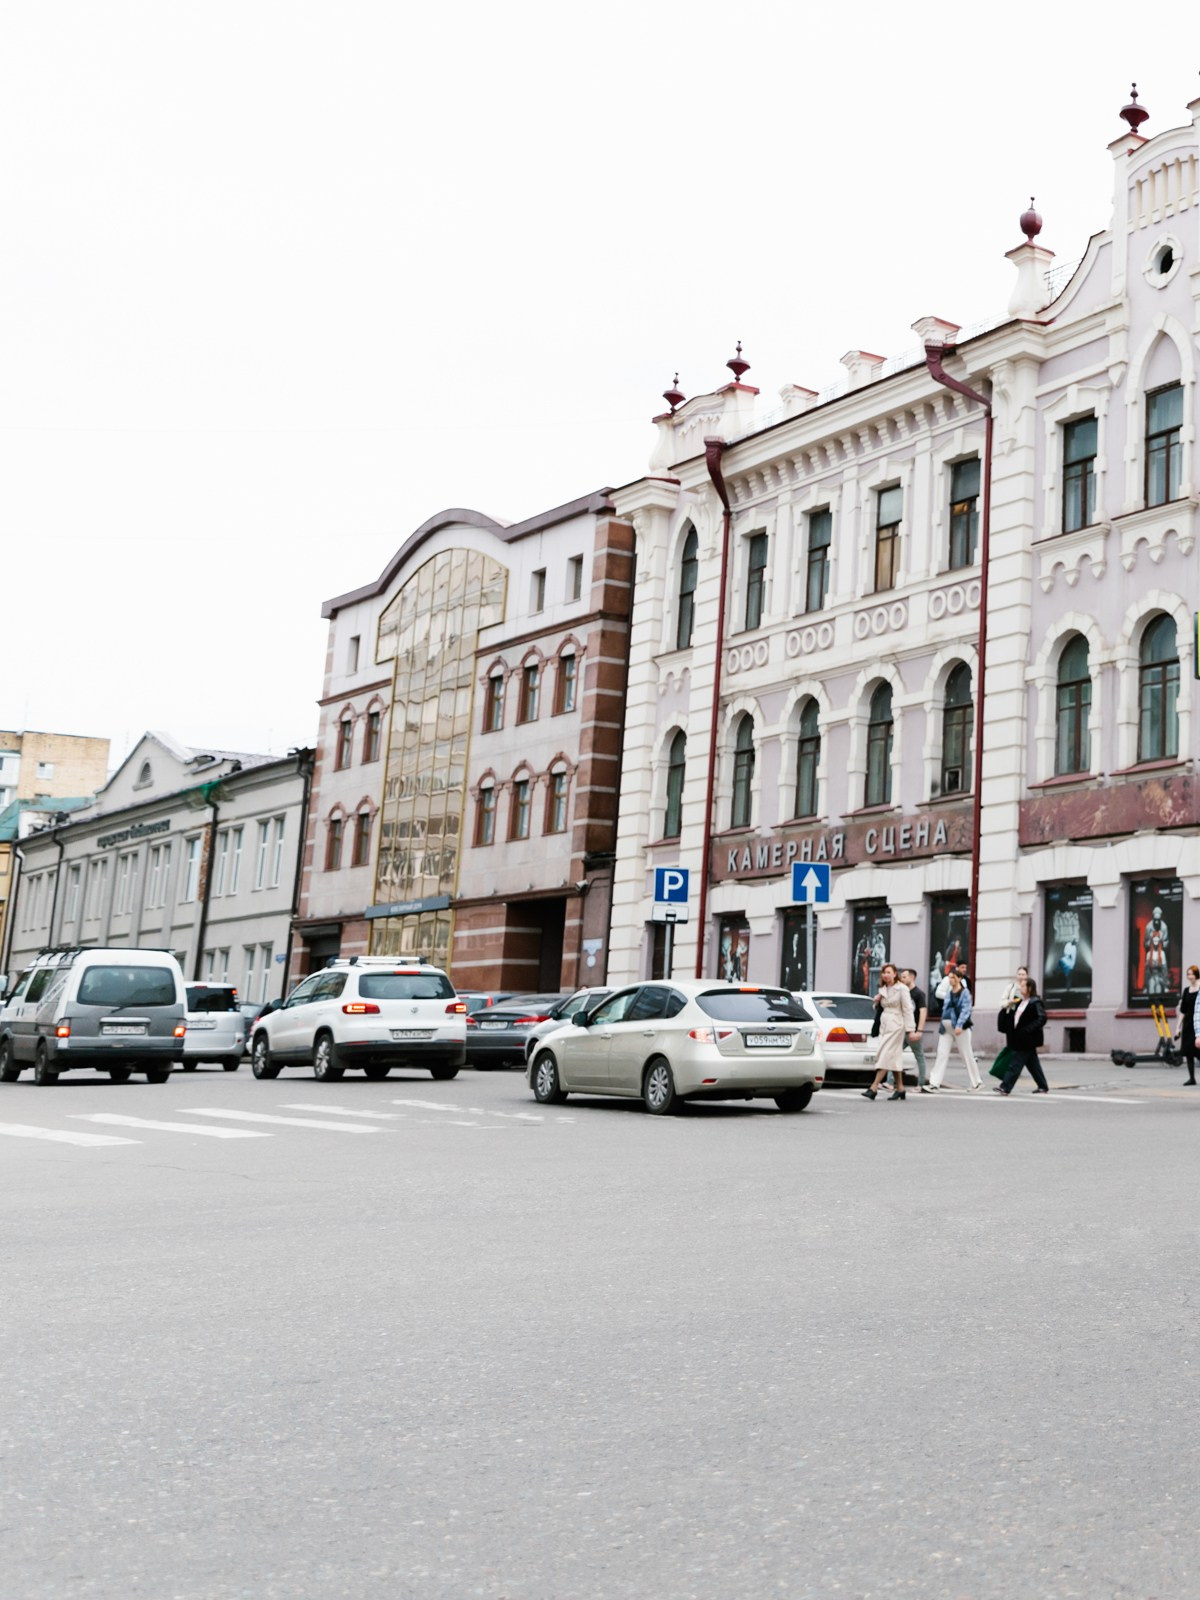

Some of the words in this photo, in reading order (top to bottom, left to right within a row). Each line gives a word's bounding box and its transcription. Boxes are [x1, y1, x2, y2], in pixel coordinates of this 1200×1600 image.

[727, 833, 845, 872] КАМЕРНАЯ
[865, 819, 948, 855] СЦЕНА
[663, 870, 684, 900] P
